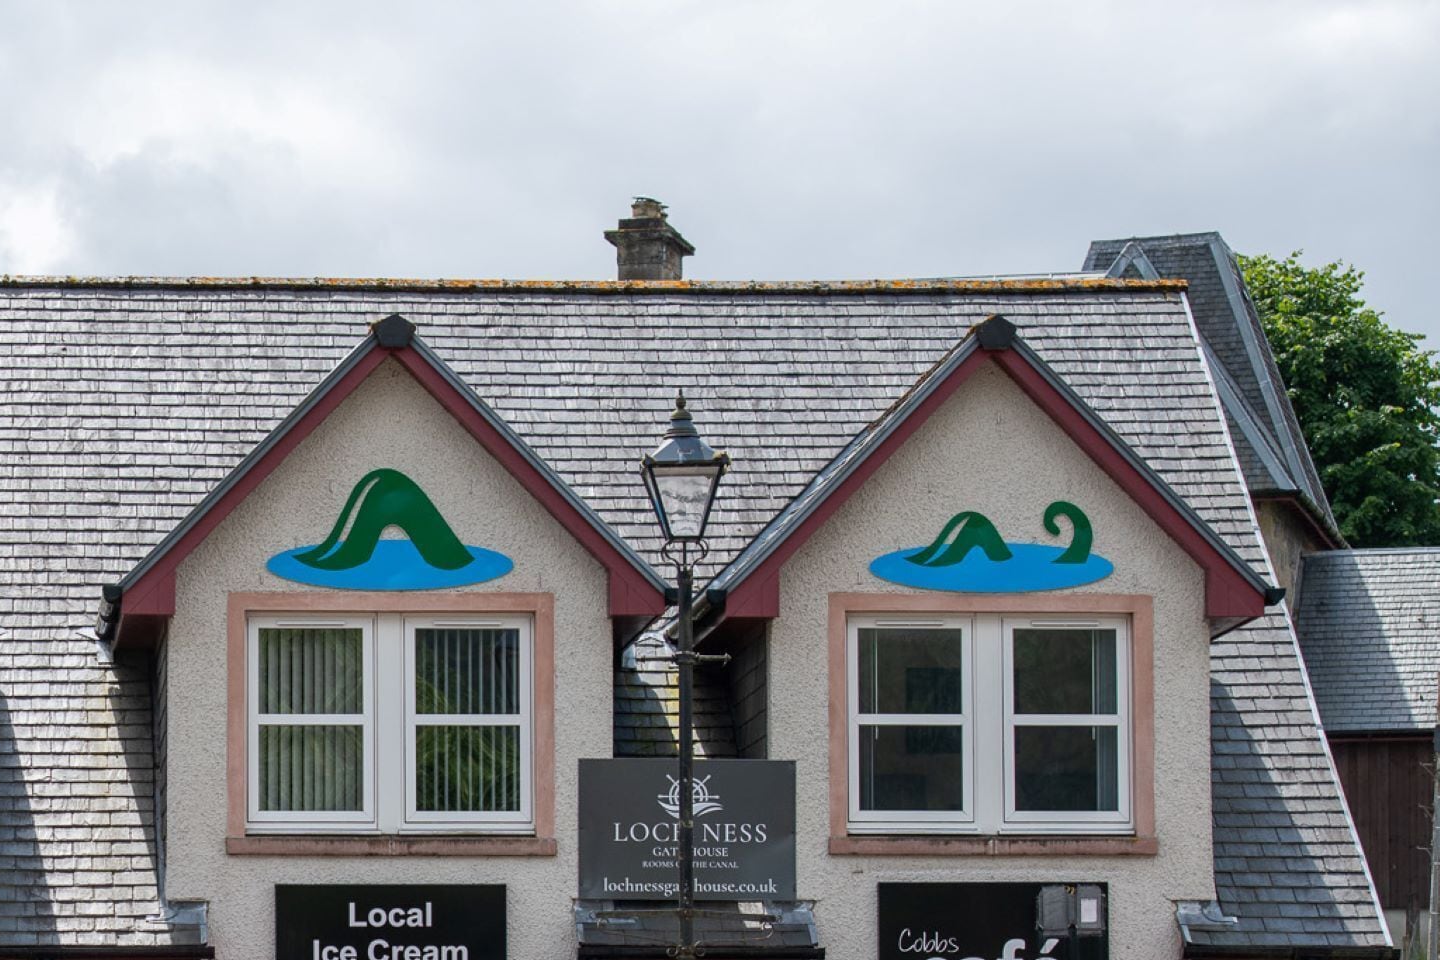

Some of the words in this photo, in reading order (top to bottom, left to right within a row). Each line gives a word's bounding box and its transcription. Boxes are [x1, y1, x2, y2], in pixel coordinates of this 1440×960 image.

[702, 823, 767, 843] NESS
[603, 877, 777, 897] lochnessgahouse.co.uk
[348, 902, 432, 928] Local
[897, 928, 959, 953] Cobbs
